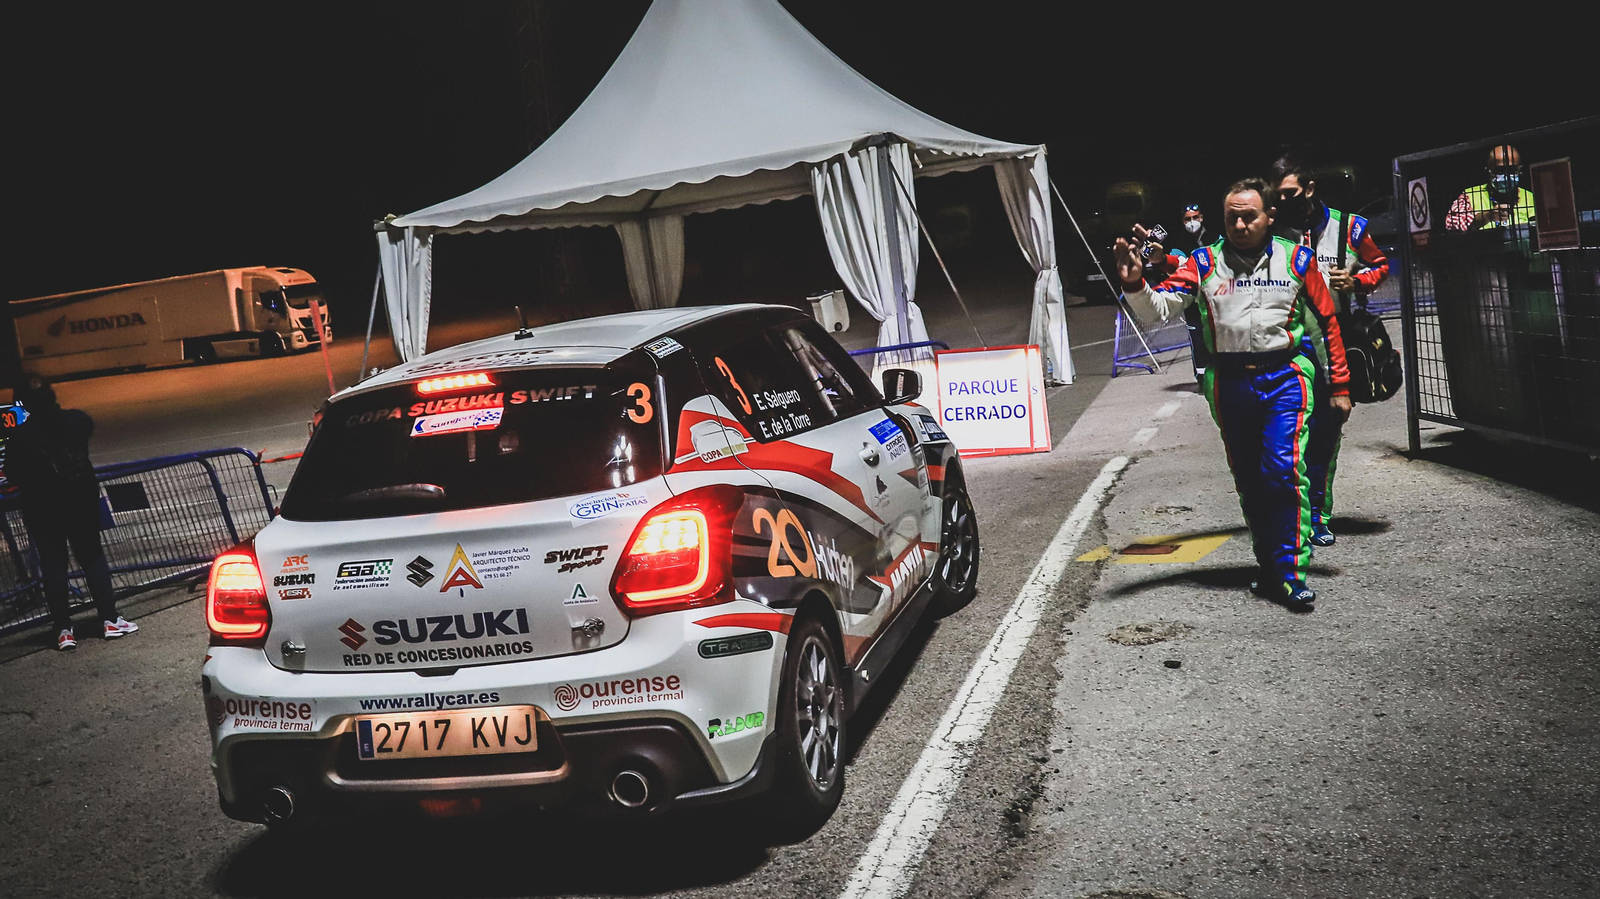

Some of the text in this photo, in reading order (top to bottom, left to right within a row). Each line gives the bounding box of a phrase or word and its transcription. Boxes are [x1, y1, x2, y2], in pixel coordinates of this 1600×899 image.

[69, 312, 146, 334] HONDA
[714, 356, 753, 415] 3
[948, 378, 1018, 396] PARQUE
[346, 385, 597, 428] COPA SUZUKI SWIFT
[626, 382, 654, 425] 3
[753, 389, 801, 411] E. Salguero
[2, 412, 16, 428] 30
[943, 404, 1027, 422] CERRADO
[759, 412, 812, 439] E. de la Torre
[701, 449, 723, 461] COPA
[283, 554, 308, 567] ARC
[473, 558, 506, 566] ARQUITECTO
[544, 545, 608, 564] SWIFT
[273, 573, 316, 587] SUZUKI
[372, 608, 530, 646] SUZUKI
[343, 641, 533, 667] RED DE CONCESIONARIOS
[580, 675, 681, 699] ourense
[226, 699, 312, 720] ourense
[360, 692, 500, 710] www.rallycar.es
[592, 690, 684, 710] provincia termal
[234, 718, 313, 732] provincia termal
[374, 714, 532, 754] 2717 KVJ
